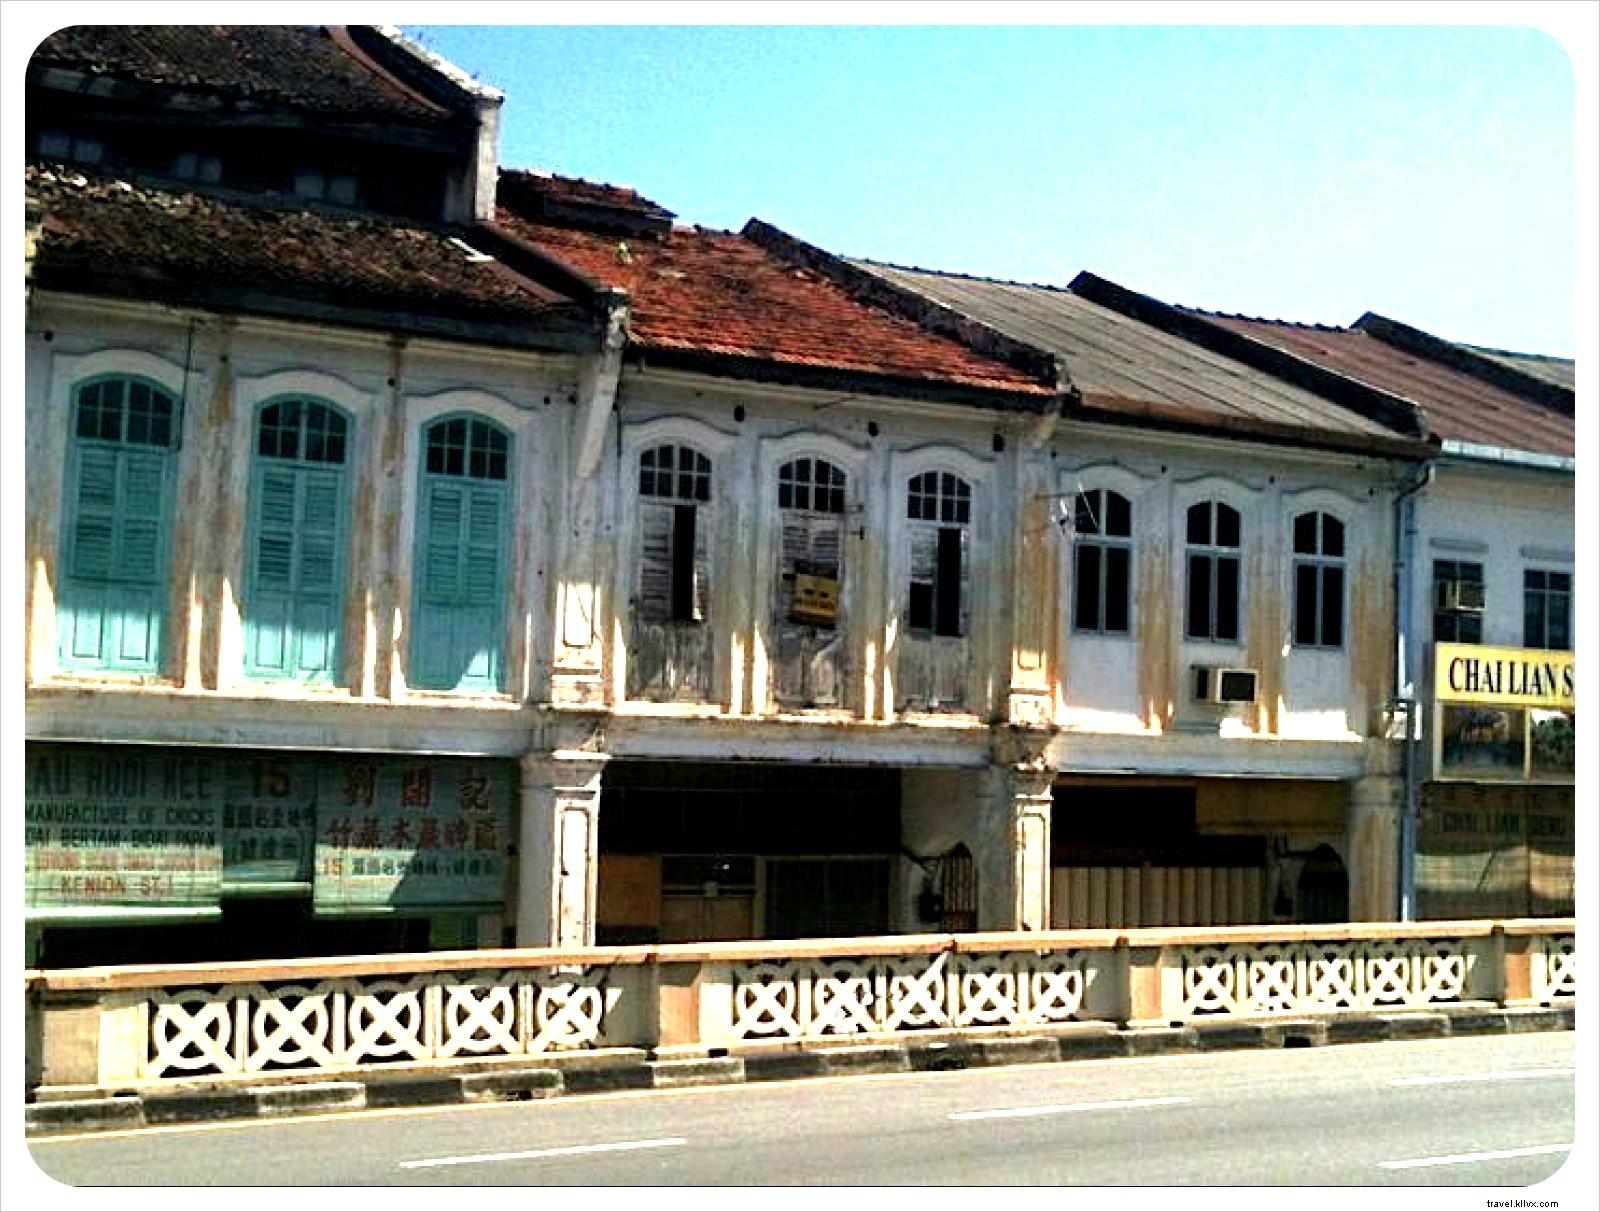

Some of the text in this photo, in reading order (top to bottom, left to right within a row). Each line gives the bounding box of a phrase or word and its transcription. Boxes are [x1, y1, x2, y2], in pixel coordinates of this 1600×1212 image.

[1449, 656, 1502, 693] CHAI
[1508, 660, 1557, 696] LIAN
[25, 755, 71, 796] AU
[252, 759, 290, 798] 15
